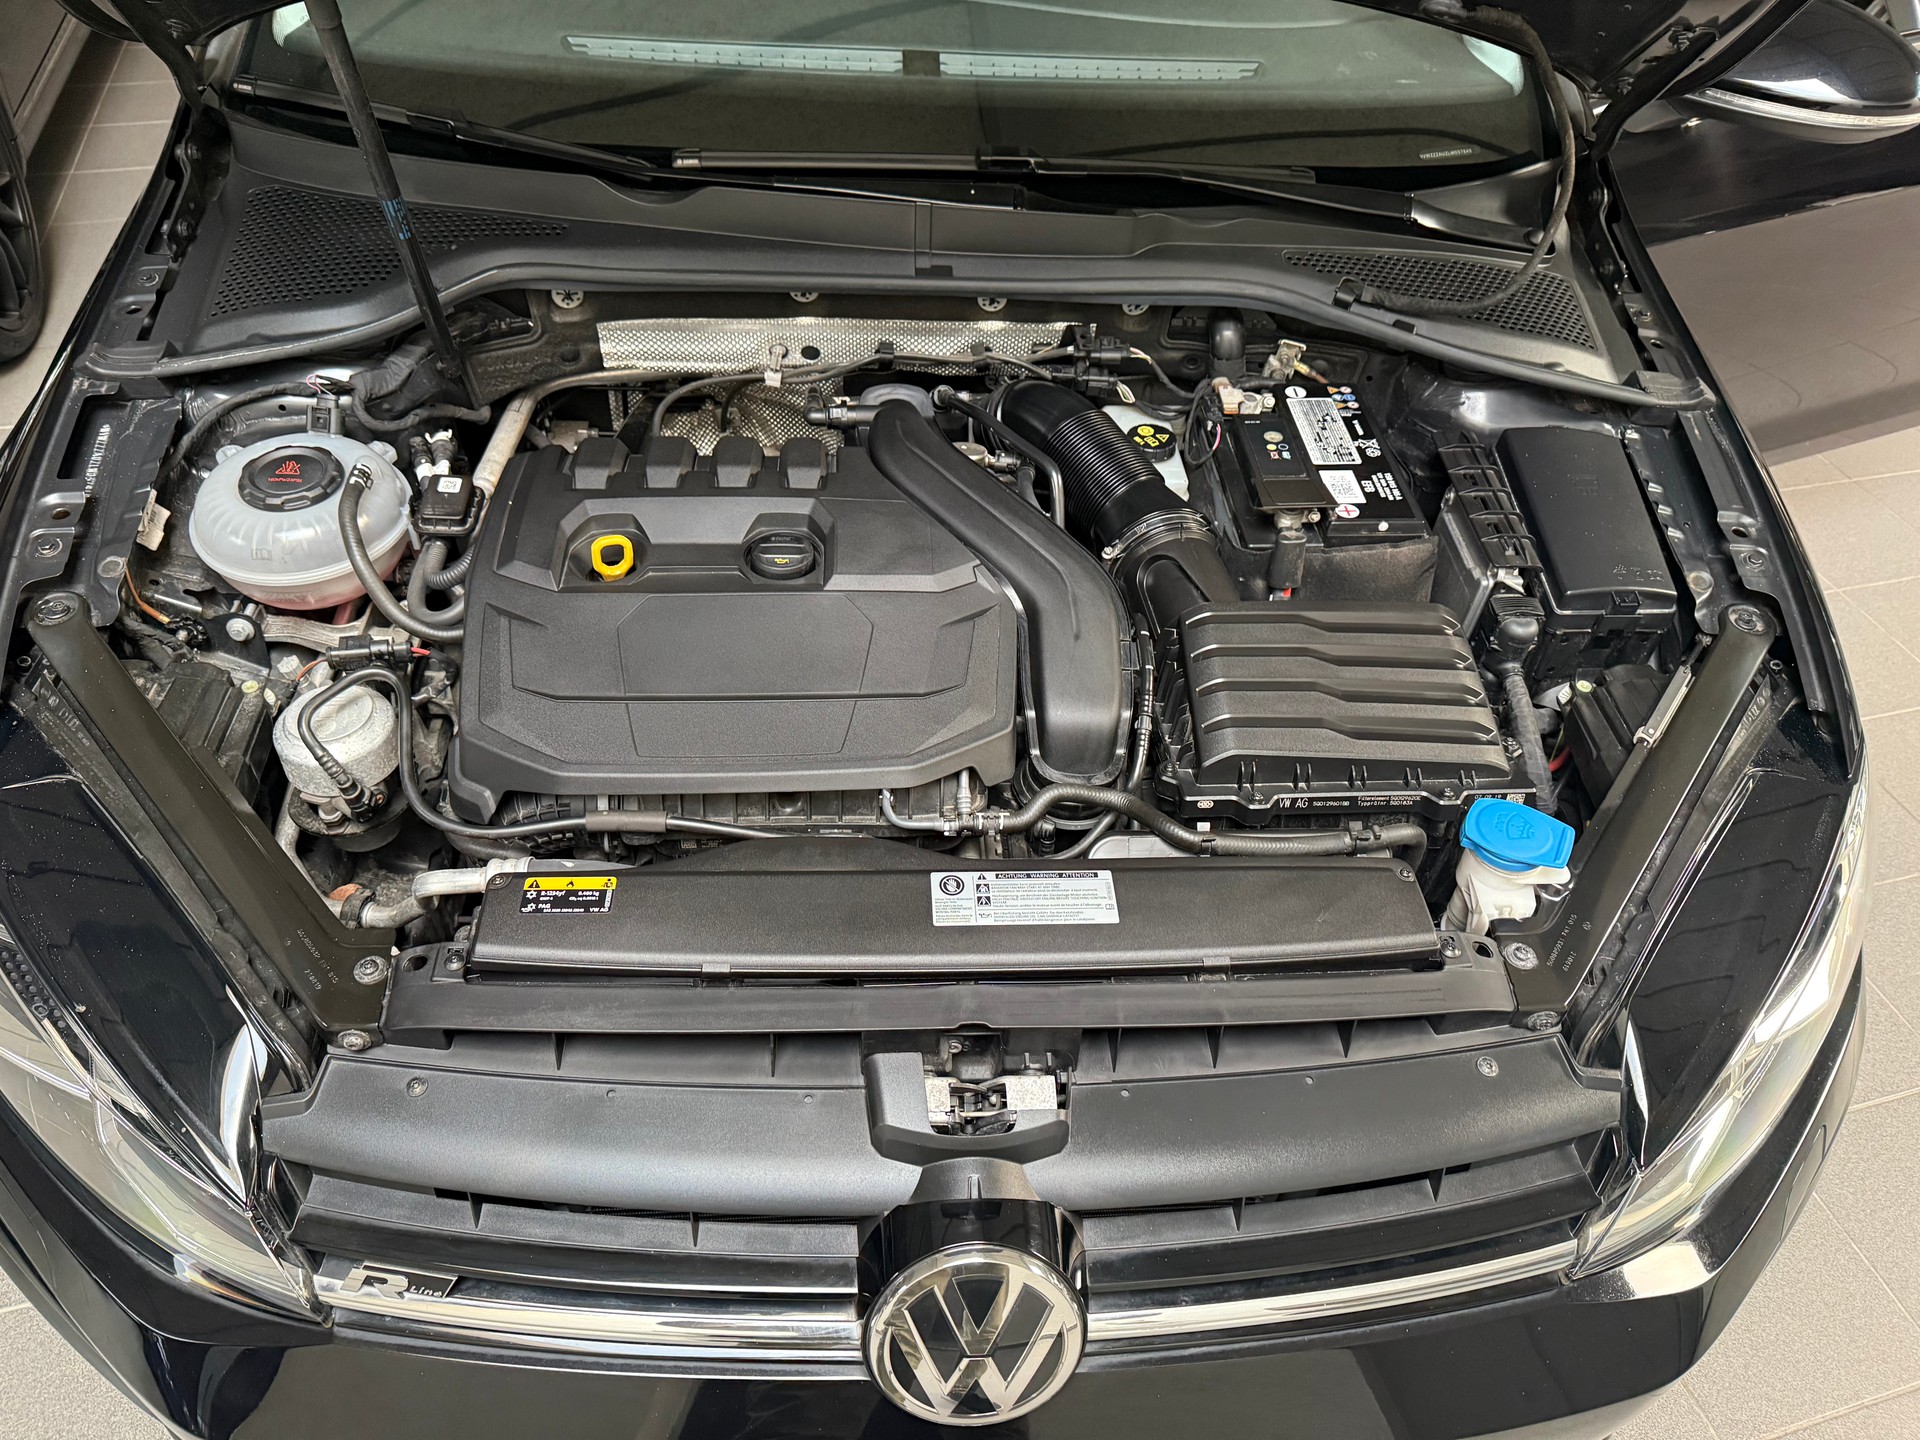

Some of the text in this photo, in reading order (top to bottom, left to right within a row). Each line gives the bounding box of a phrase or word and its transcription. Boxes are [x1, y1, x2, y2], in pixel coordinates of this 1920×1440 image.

[1280, 798, 1291, 808] VW
[1295, 798, 1308, 808] AG
[340, 1268, 443, 1300] R Line
